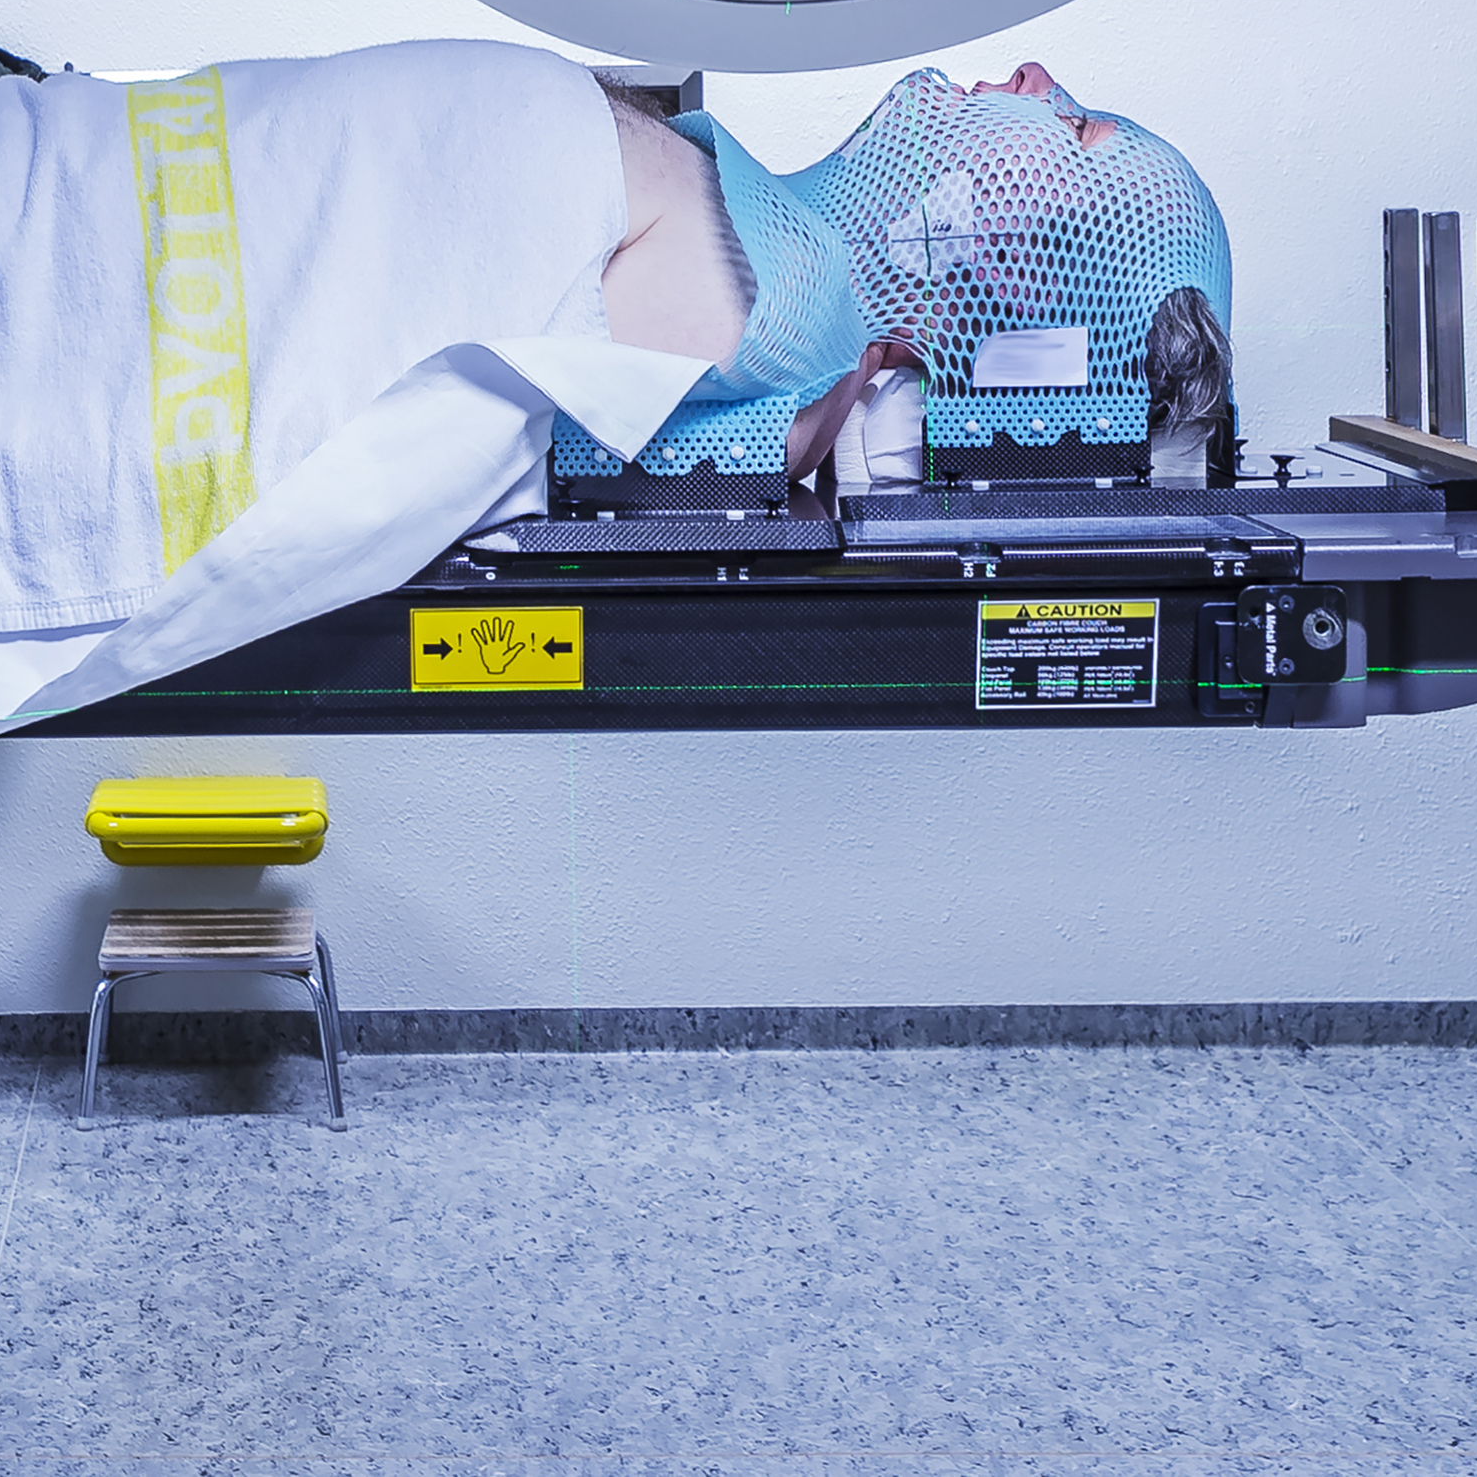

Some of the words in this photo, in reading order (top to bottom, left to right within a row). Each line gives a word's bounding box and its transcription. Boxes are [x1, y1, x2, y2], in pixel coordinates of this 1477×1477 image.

[963, 562, 974, 578] H2
[986, 562, 997, 578] F2
[1036, 604, 1122, 617] CAUTION
[1265, 615, 1277, 643] Metal
[1265, 645, 1277, 674] Parts
